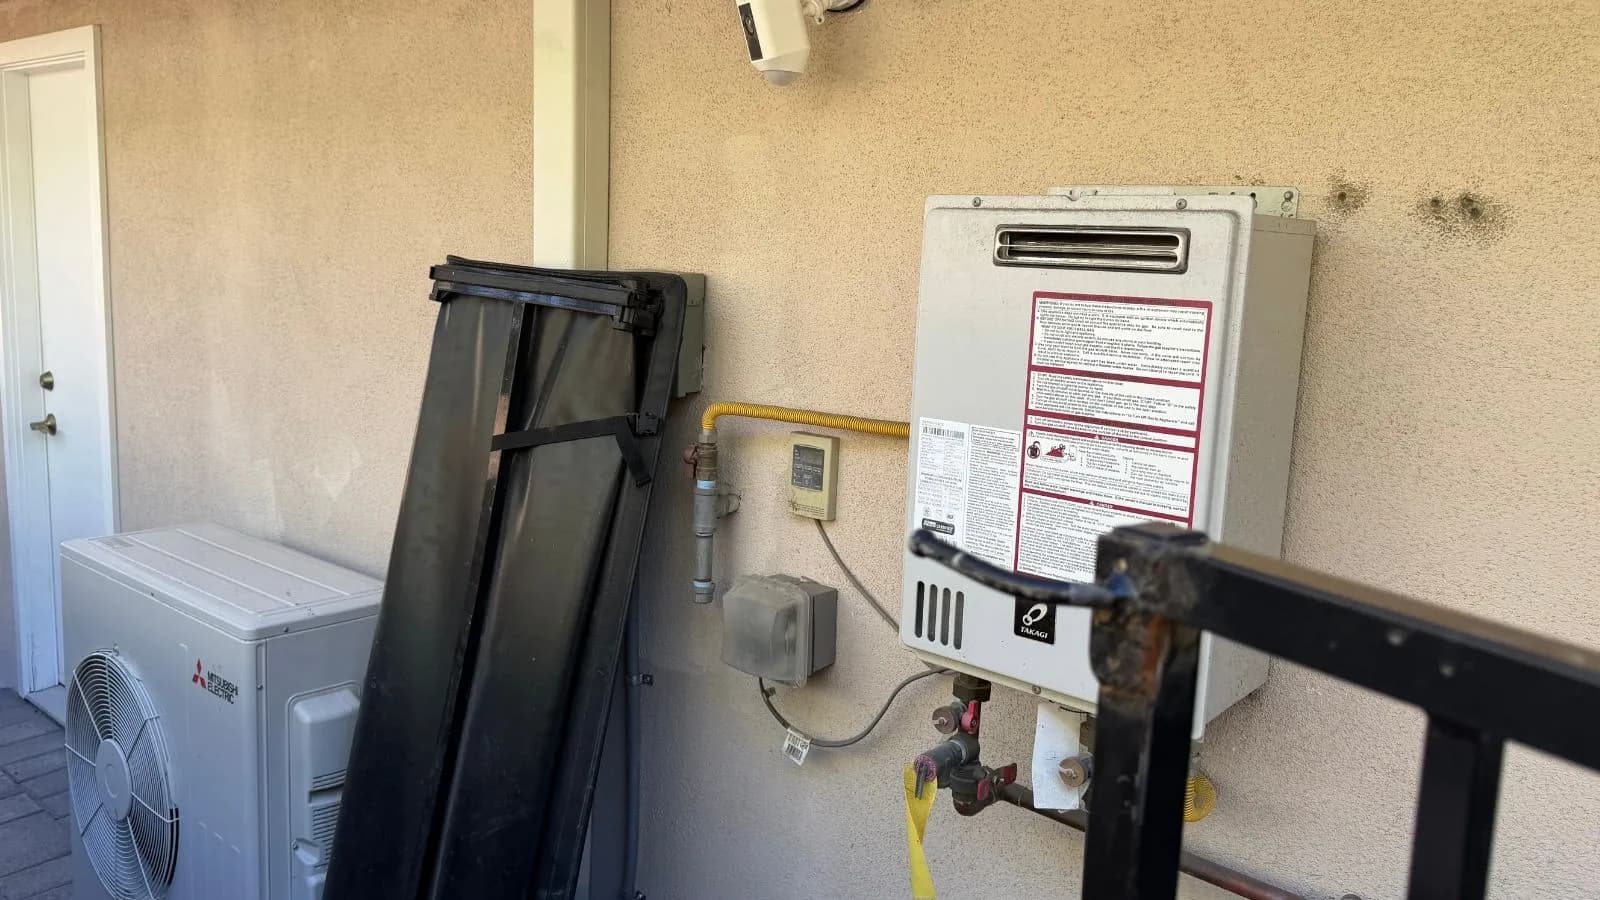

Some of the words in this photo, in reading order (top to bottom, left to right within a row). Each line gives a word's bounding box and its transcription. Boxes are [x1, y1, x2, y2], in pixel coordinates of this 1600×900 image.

[1021, 626, 1048, 639] TAKAGI
[207, 670, 239, 696] MITSUBISHI
[207, 681, 235, 704] ELECTRIC
